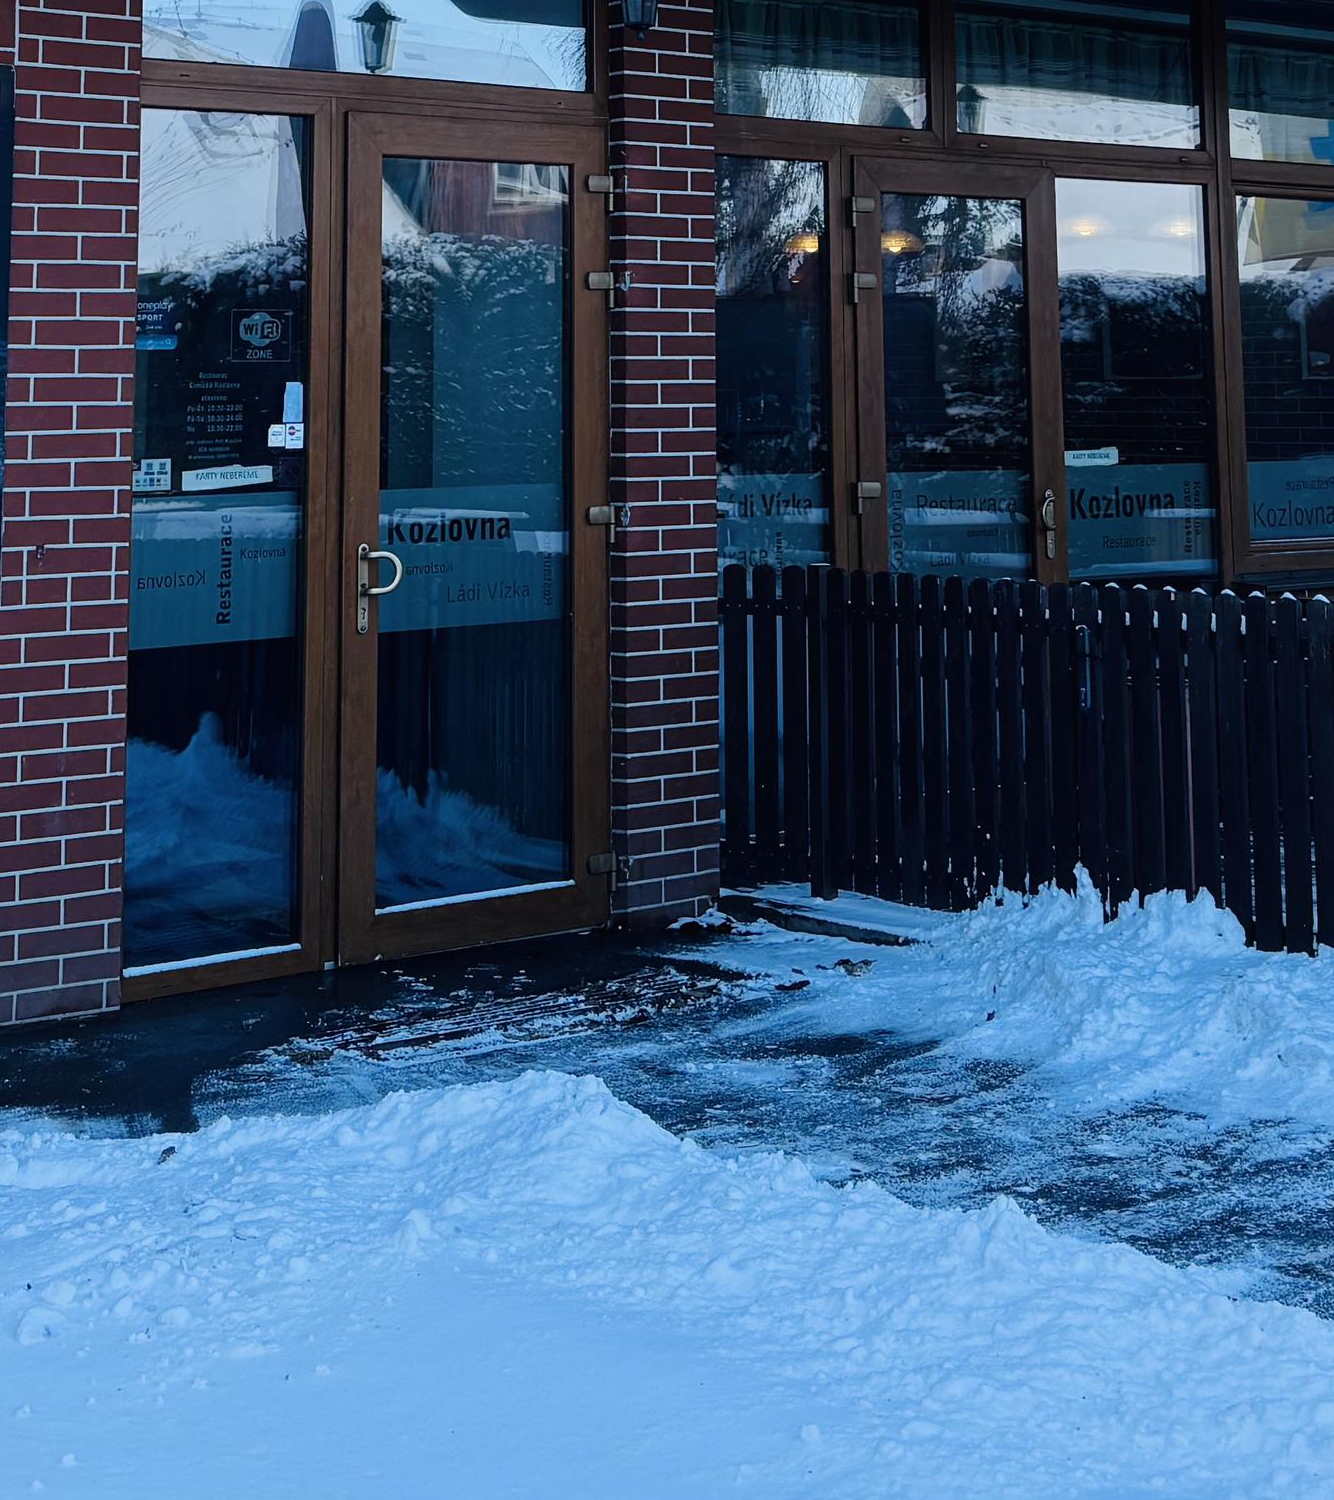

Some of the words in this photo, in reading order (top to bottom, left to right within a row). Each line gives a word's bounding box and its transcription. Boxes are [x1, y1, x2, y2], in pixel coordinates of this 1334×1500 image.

[246, 349, 273, 360] ZONE
[196, 472, 217, 480] KARTY
[219, 470, 258, 480] NEBEREME
[761, 491, 813, 517] Vízka
[916, 493, 1017, 517] Restaurace
[1069, 485, 1176, 520] Kozlovna
[388, 512, 512, 546] Kozlovna
[240, 546, 286, 560] Kozlovna
[216, 513, 233, 625] Restaurace
[446, 582, 481, 604] Ládi
[487, 581, 530, 600] Vízka
